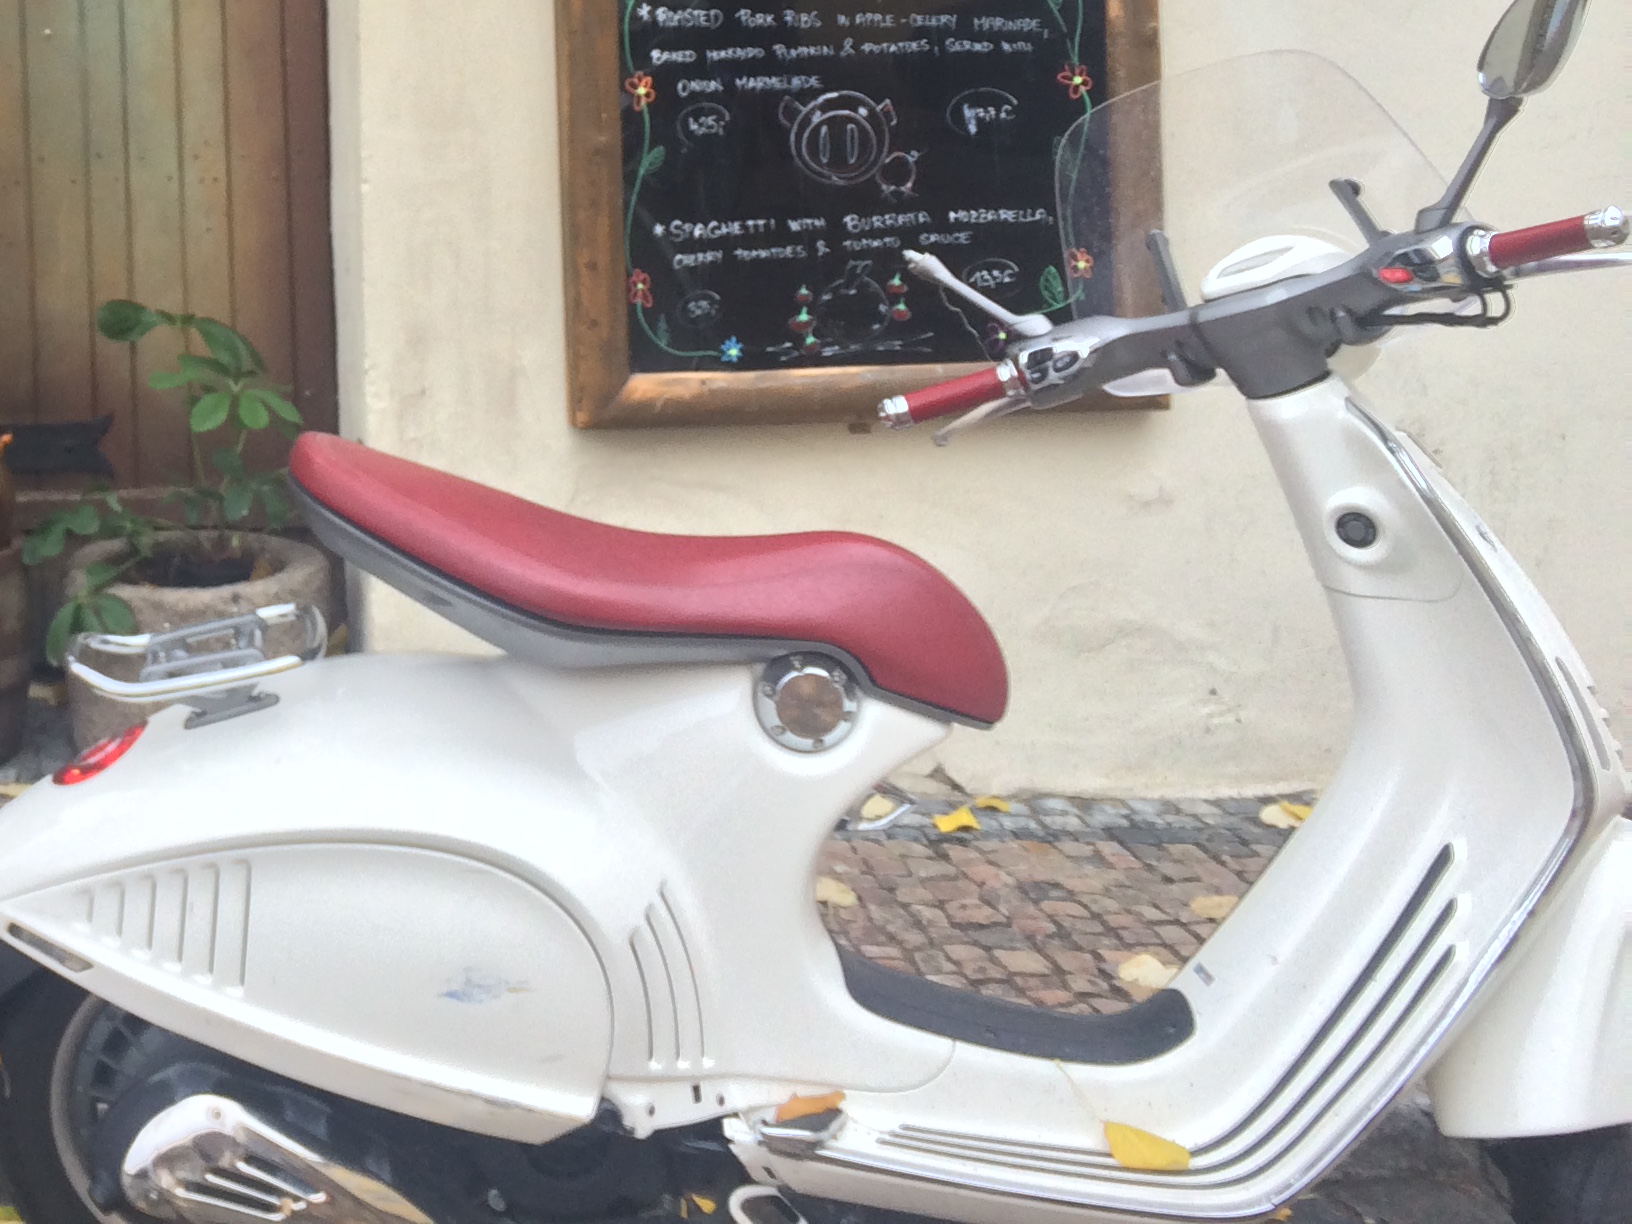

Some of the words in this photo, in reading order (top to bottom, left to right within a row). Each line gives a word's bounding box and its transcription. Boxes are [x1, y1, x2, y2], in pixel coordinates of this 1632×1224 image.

[669, 218, 776, 243] SPAGHETTI
[843, 210, 932, 234] BURRATA
[918, 230, 974, 247] SAUCE
